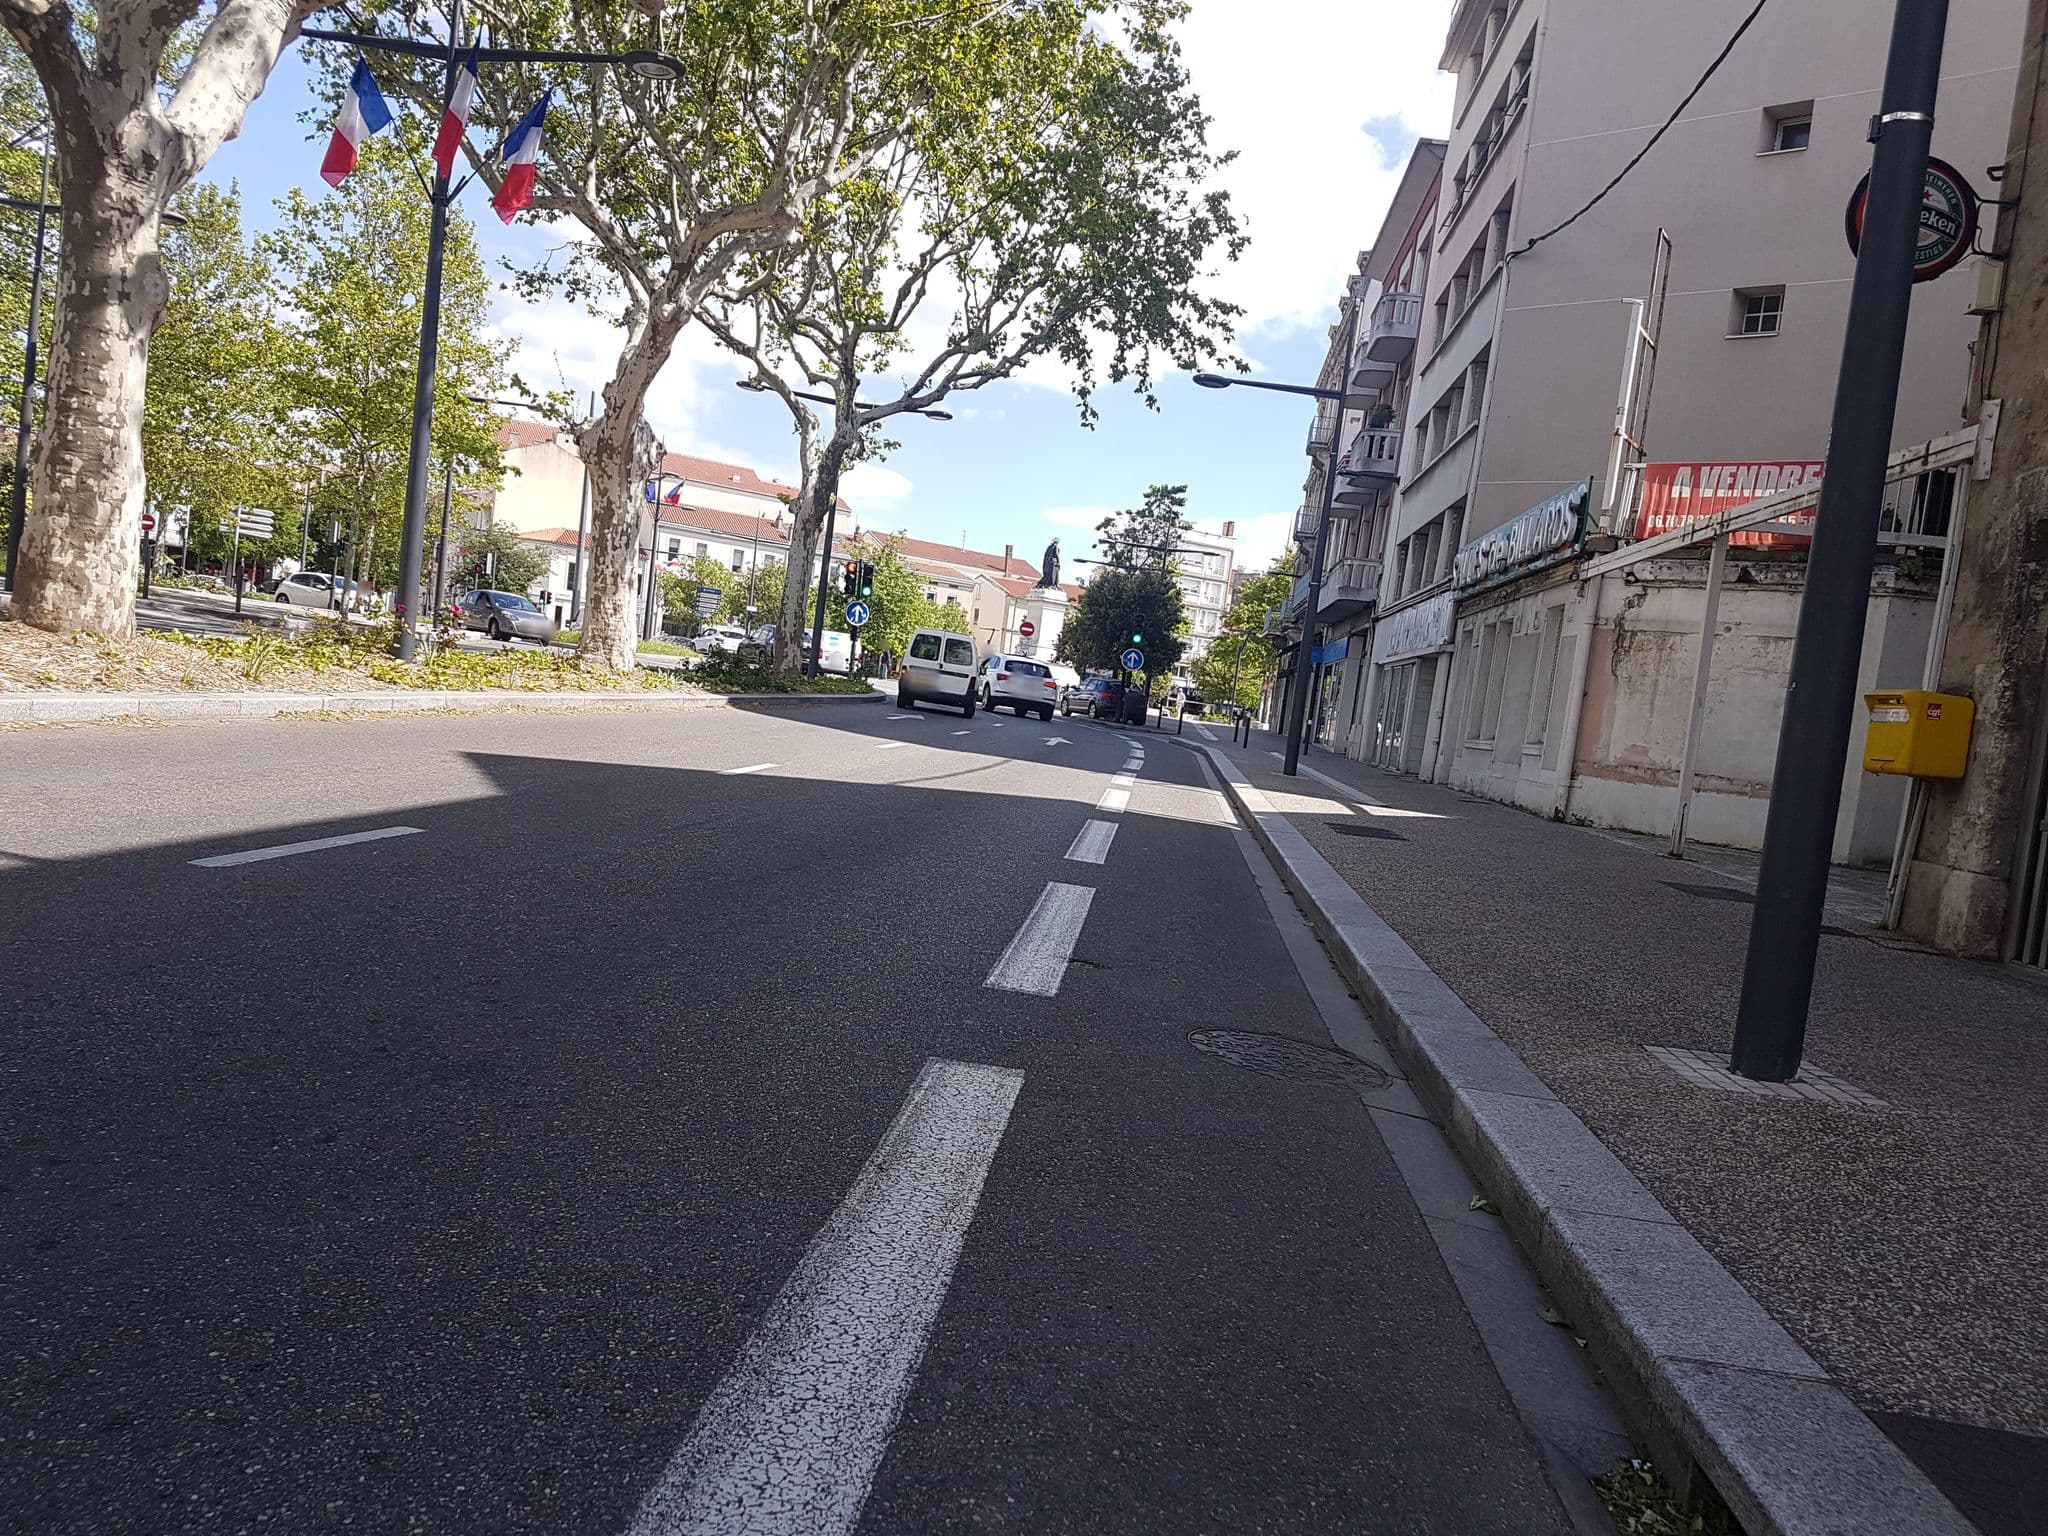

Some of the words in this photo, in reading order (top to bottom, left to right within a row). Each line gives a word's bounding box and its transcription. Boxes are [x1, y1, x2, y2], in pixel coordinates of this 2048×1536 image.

[1920, 210, 1956, 235] eken
[1915, 243, 1944, 260] ESTIGE
[1671, 466, 1692, 498] A
